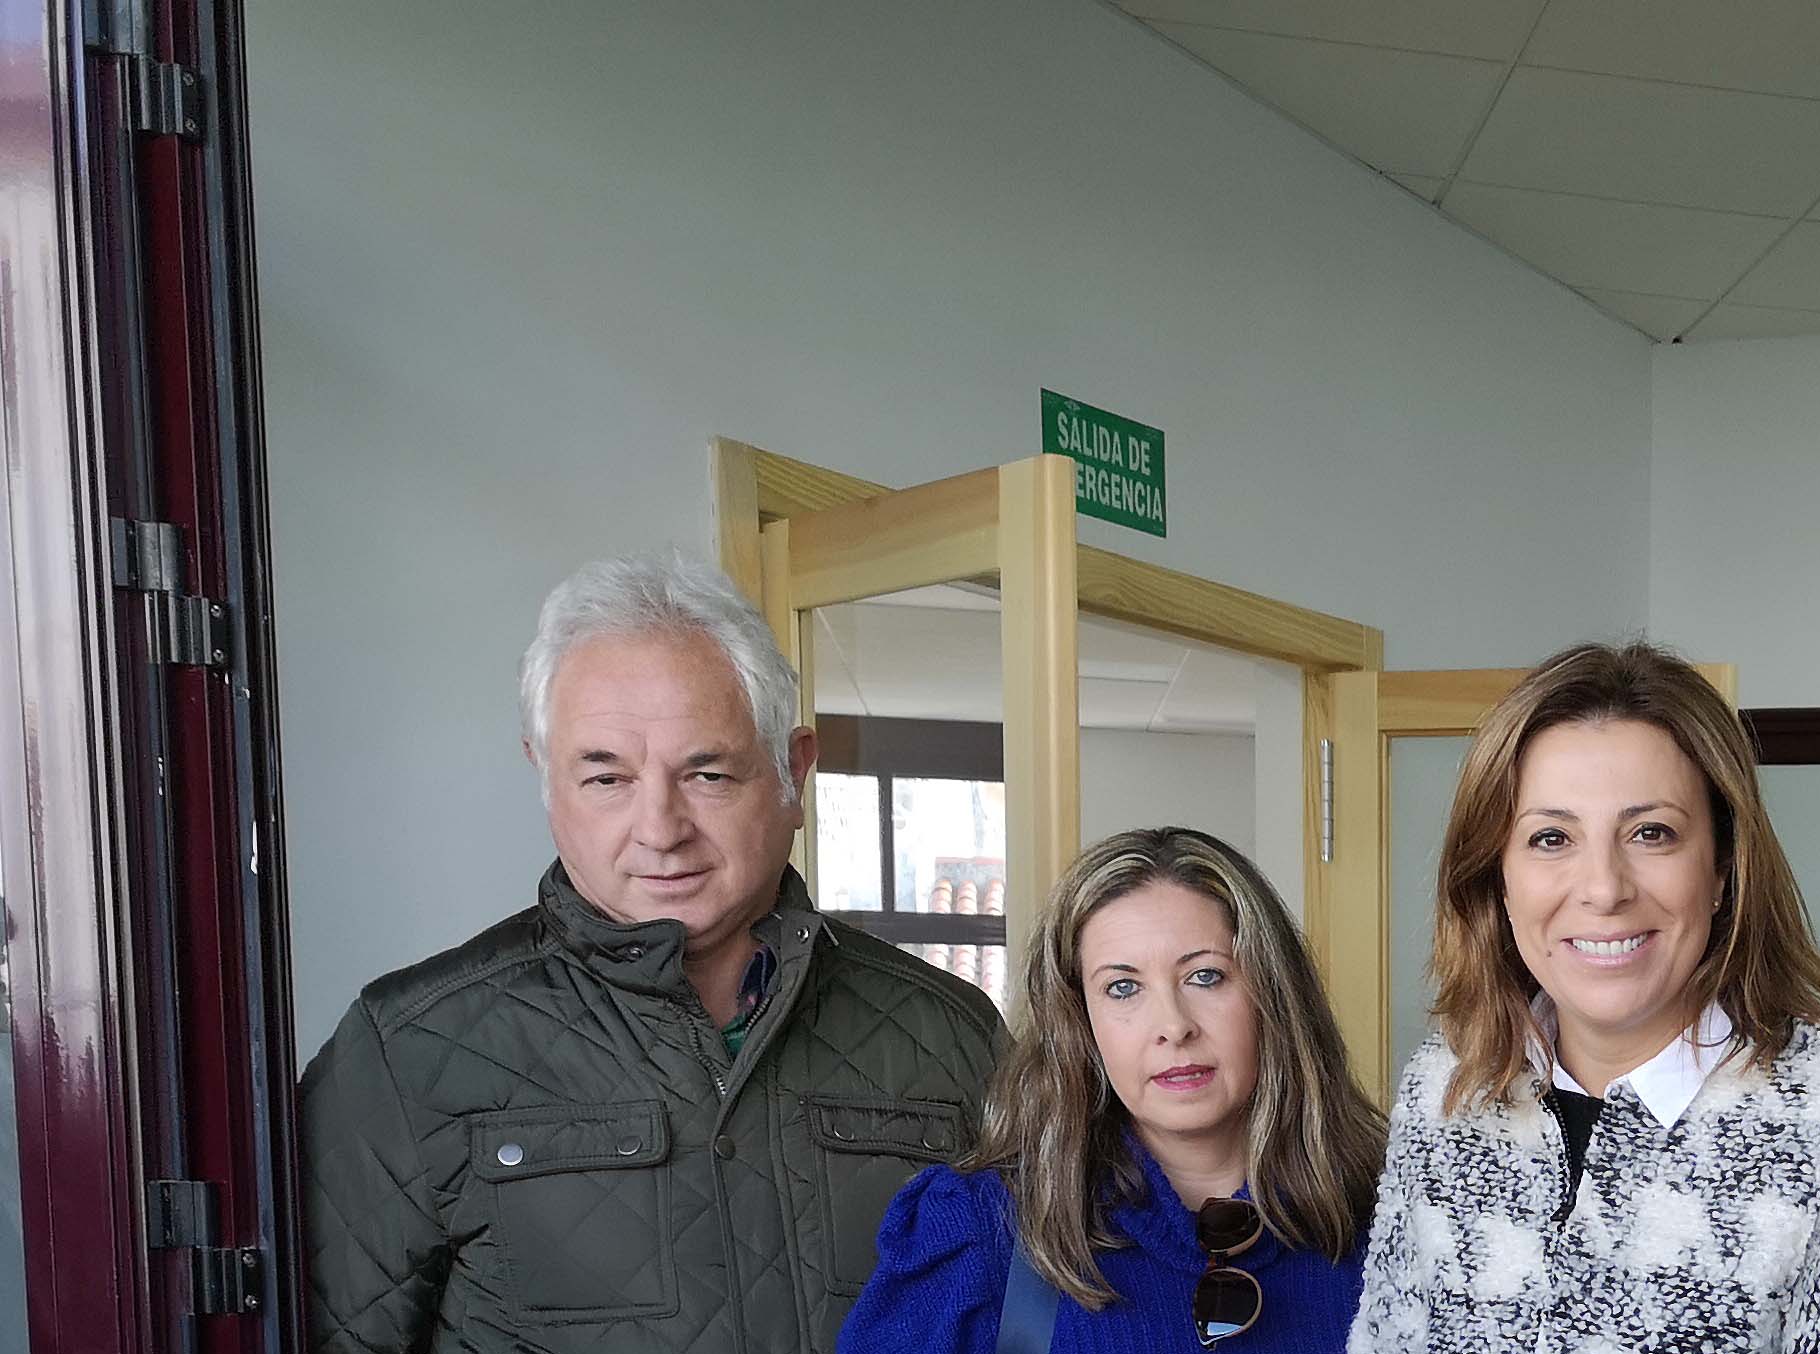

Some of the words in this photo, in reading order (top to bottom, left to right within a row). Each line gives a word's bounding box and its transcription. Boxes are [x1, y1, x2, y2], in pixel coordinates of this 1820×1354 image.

[1057, 411, 1123, 467] SALIDA
[1128, 436, 1151, 476] DE
[1075, 462, 1163, 522] ERGENCIA
